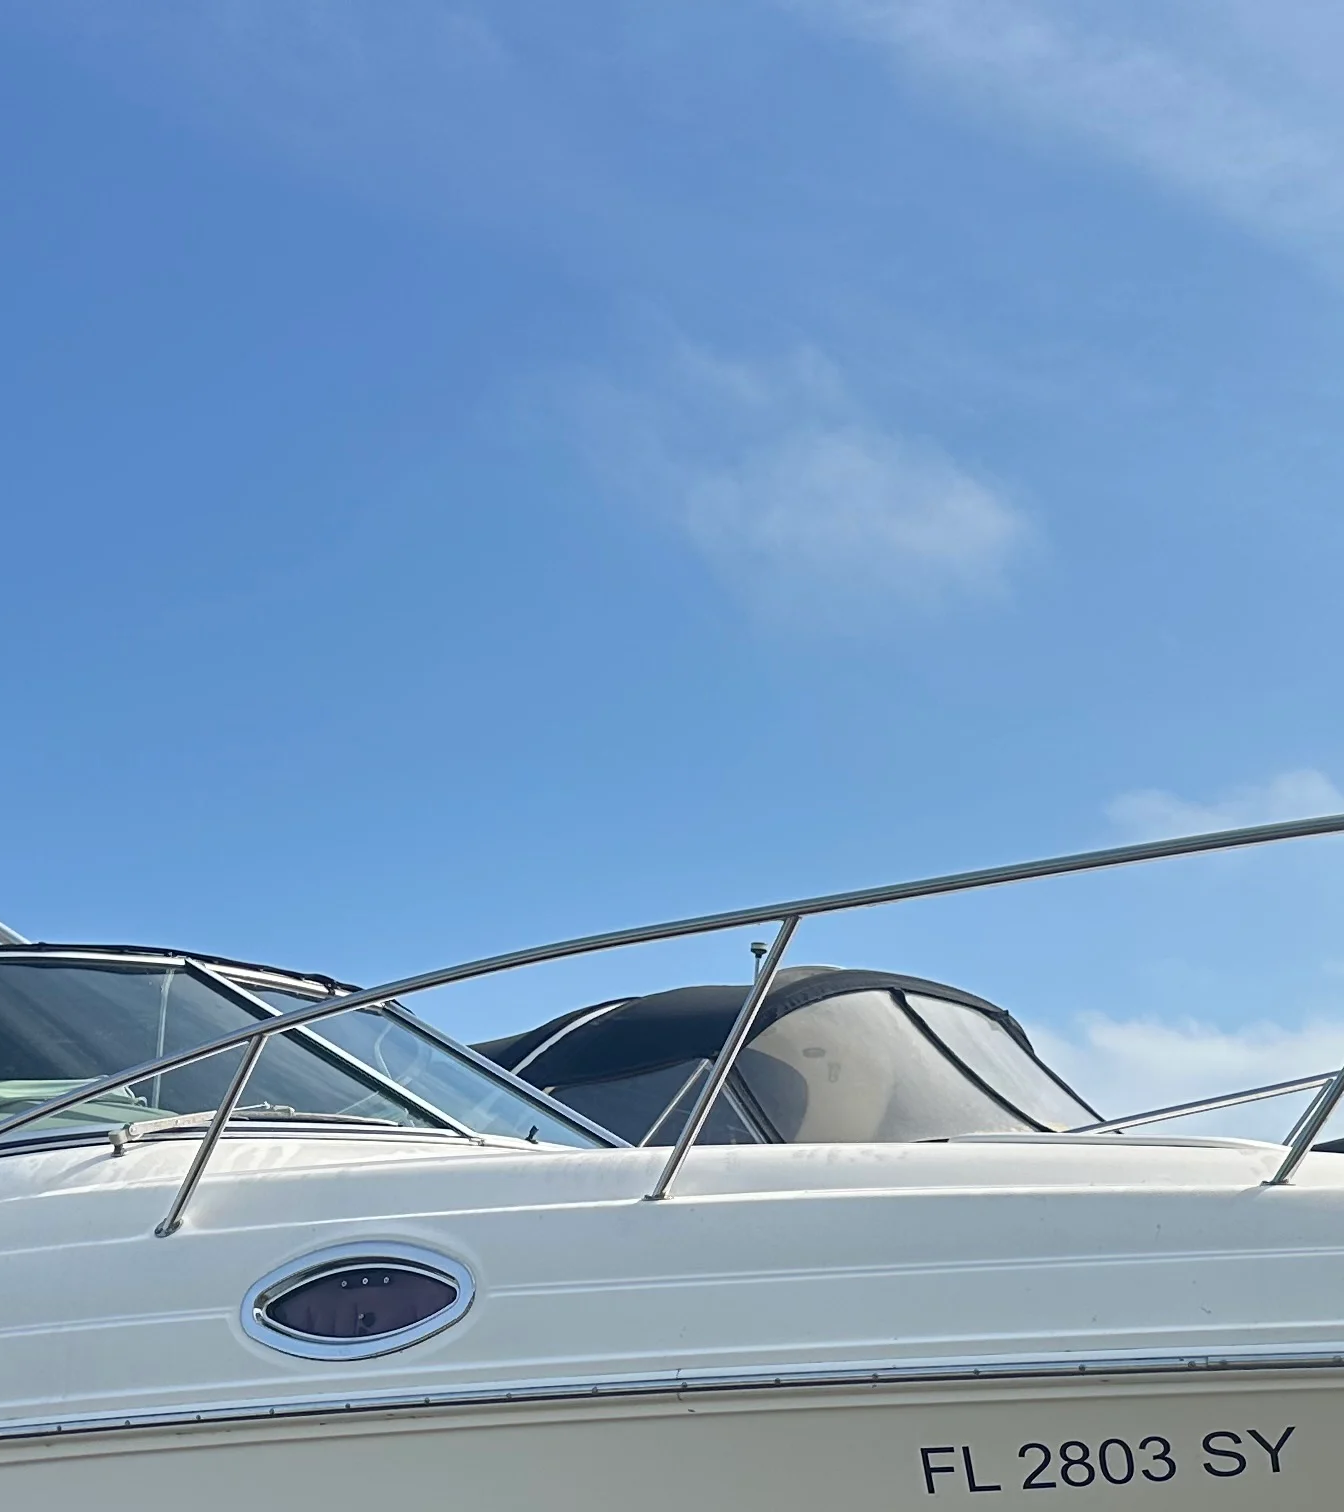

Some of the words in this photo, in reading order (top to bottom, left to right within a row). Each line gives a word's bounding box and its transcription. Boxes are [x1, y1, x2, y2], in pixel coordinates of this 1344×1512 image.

[920, 1445, 1002, 1494] FL
[1018, 1436, 1177, 1490] 2803
[1202, 1426, 1296, 1478] SY
